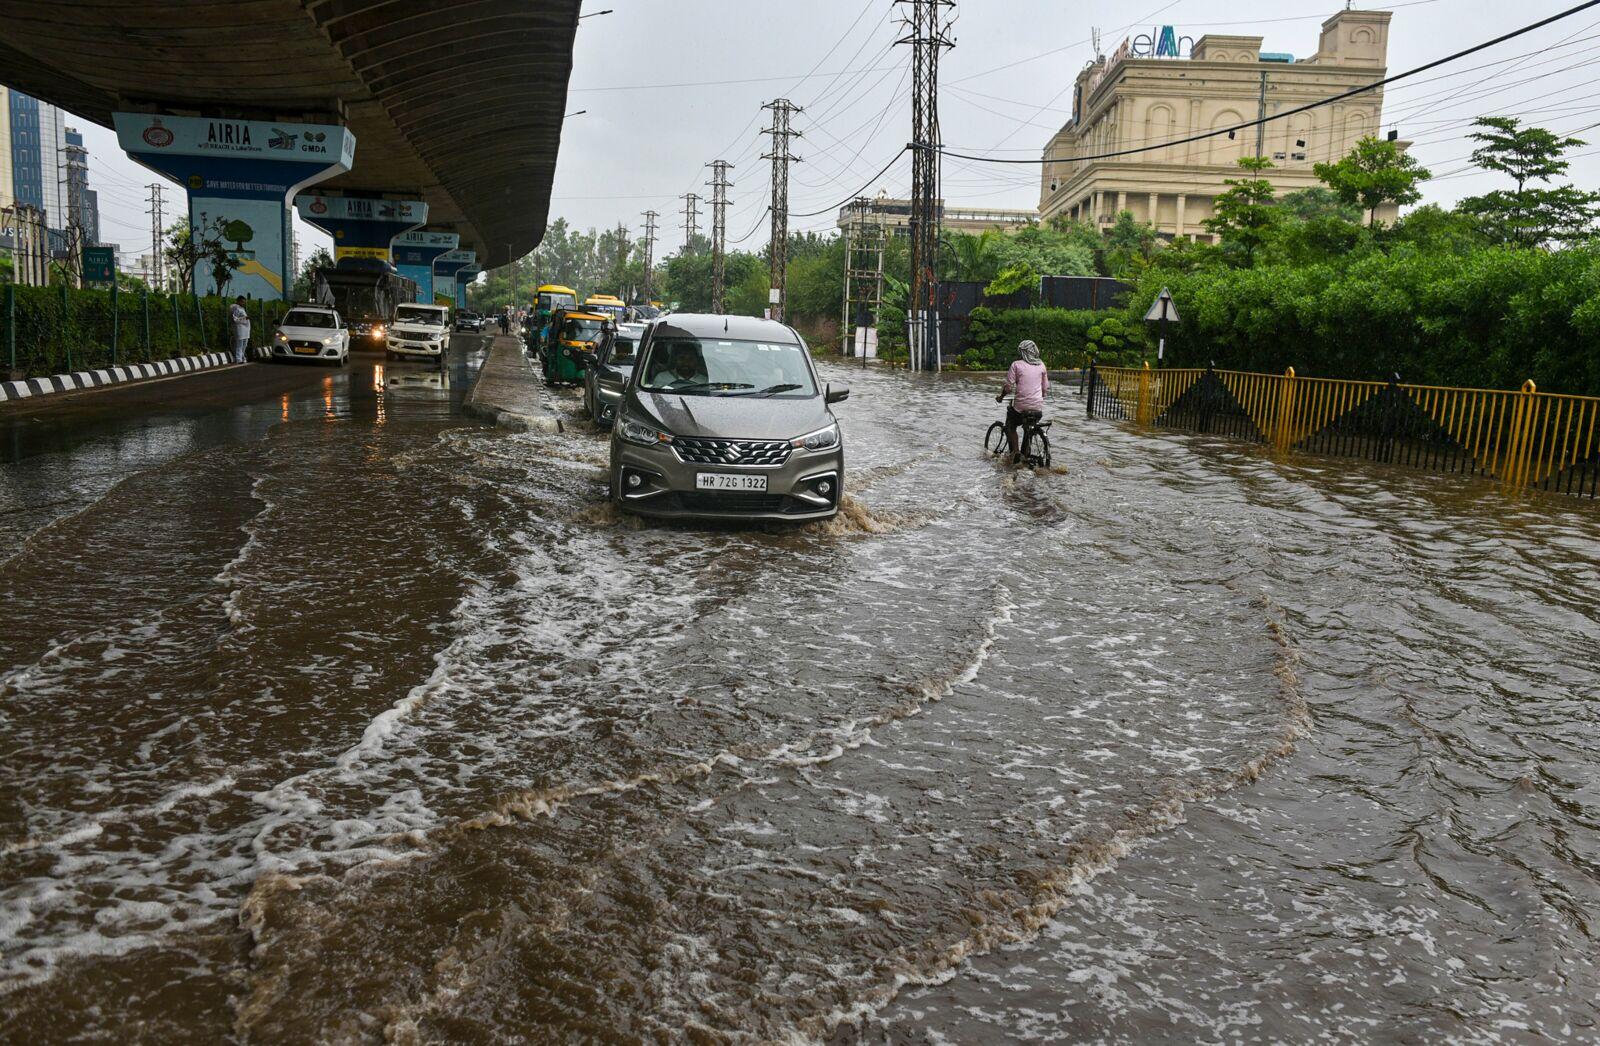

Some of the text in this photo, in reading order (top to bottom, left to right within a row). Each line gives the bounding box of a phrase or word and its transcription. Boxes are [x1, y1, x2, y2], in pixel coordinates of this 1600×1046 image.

[207, 122, 251, 145] AIRIA
[301, 144, 327, 153] GMDA
[347, 200, 372, 212] AIRIA
[406, 232, 424, 242] AIRIA
[703, 476, 766, 489] HR 72G 1322
